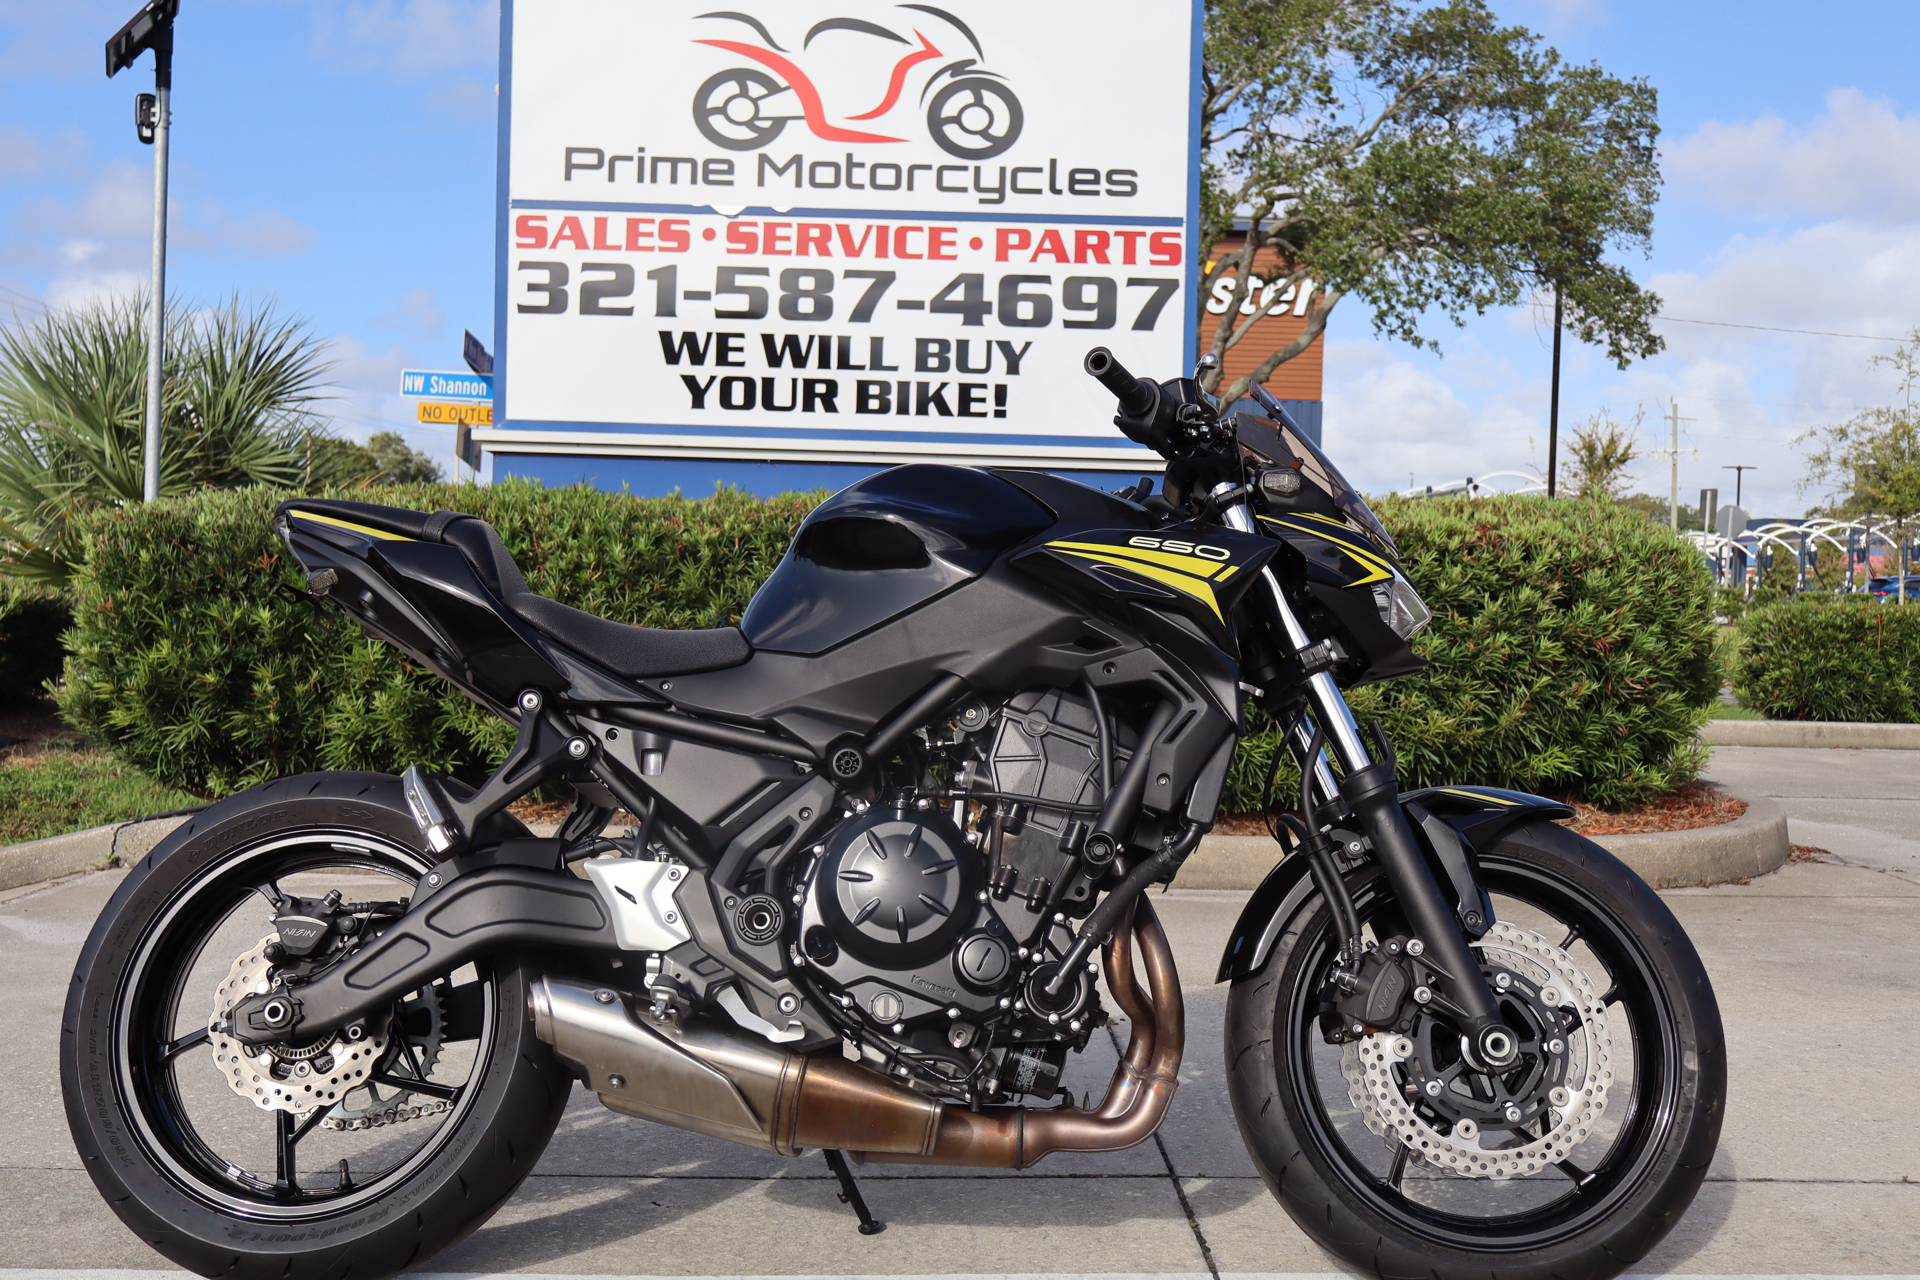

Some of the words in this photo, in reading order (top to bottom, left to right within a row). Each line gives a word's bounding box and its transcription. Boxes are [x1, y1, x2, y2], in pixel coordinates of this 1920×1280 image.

[565, 147, 734, 185] Prime
[758, 153, 1137, 204] Motorcycles
[516, 216, 690, 252] SALES
[726, 222, 957, 260] SERVICE
[996, 228, 1183, 266] PARTS
[517, 261, 1180, 331] 321-587-4697
[658, 331, 745, 367] WE
[760, 333, 899, 371] WILL
[915, 338, 1033, 375] BUY
[404, 375, 425, 393] NW
[430, 376, 487, 396] Shannon
[680, 374, 839, 413] YOUR
[855, 380, 1007, 418] BIKE!
[422, 406, 443, 420] NO
[1128, 536, 1231, 560] 650
[203, 809, 288, 852] DUNLOP
